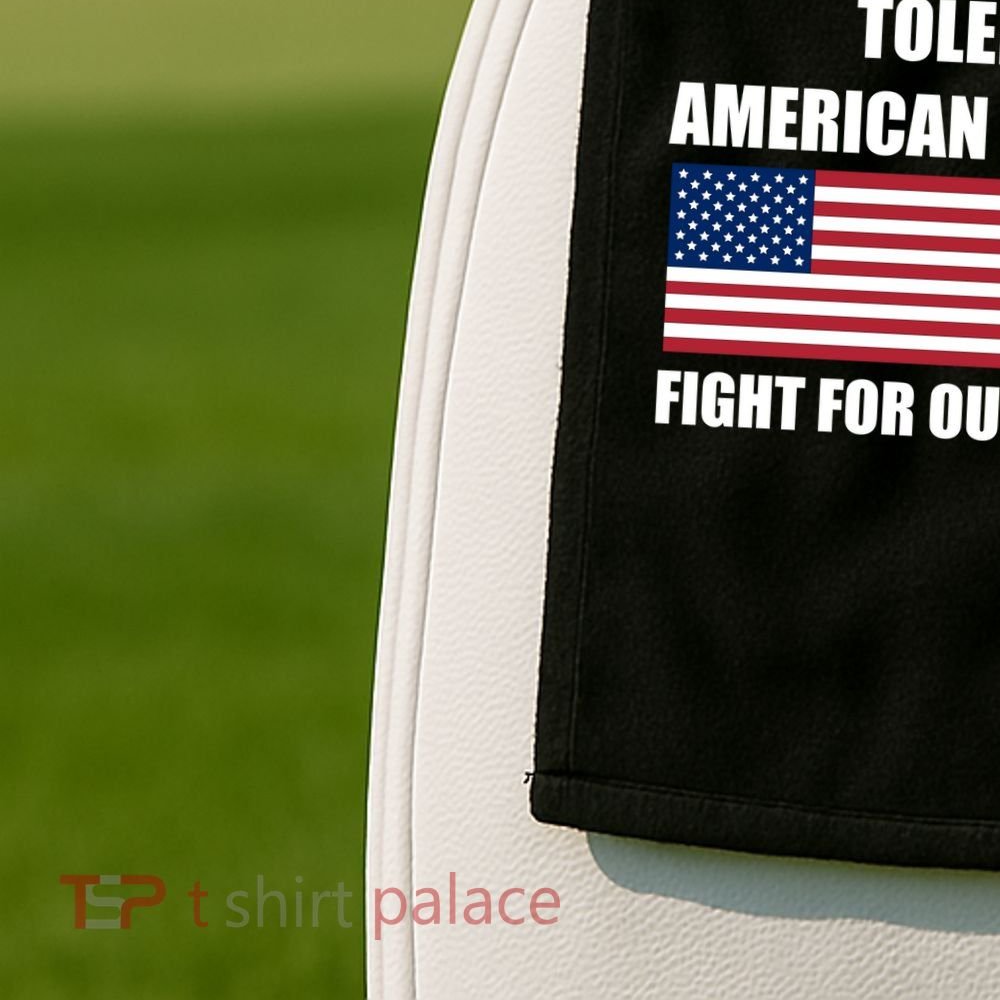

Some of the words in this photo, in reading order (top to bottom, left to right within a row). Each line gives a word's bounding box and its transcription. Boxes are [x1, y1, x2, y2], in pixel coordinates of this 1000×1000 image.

[668, 81, 989, 160] AMERICAN
[654, 369, 806, 431] FIGHT
[817, 377, 915, 437] FOR
